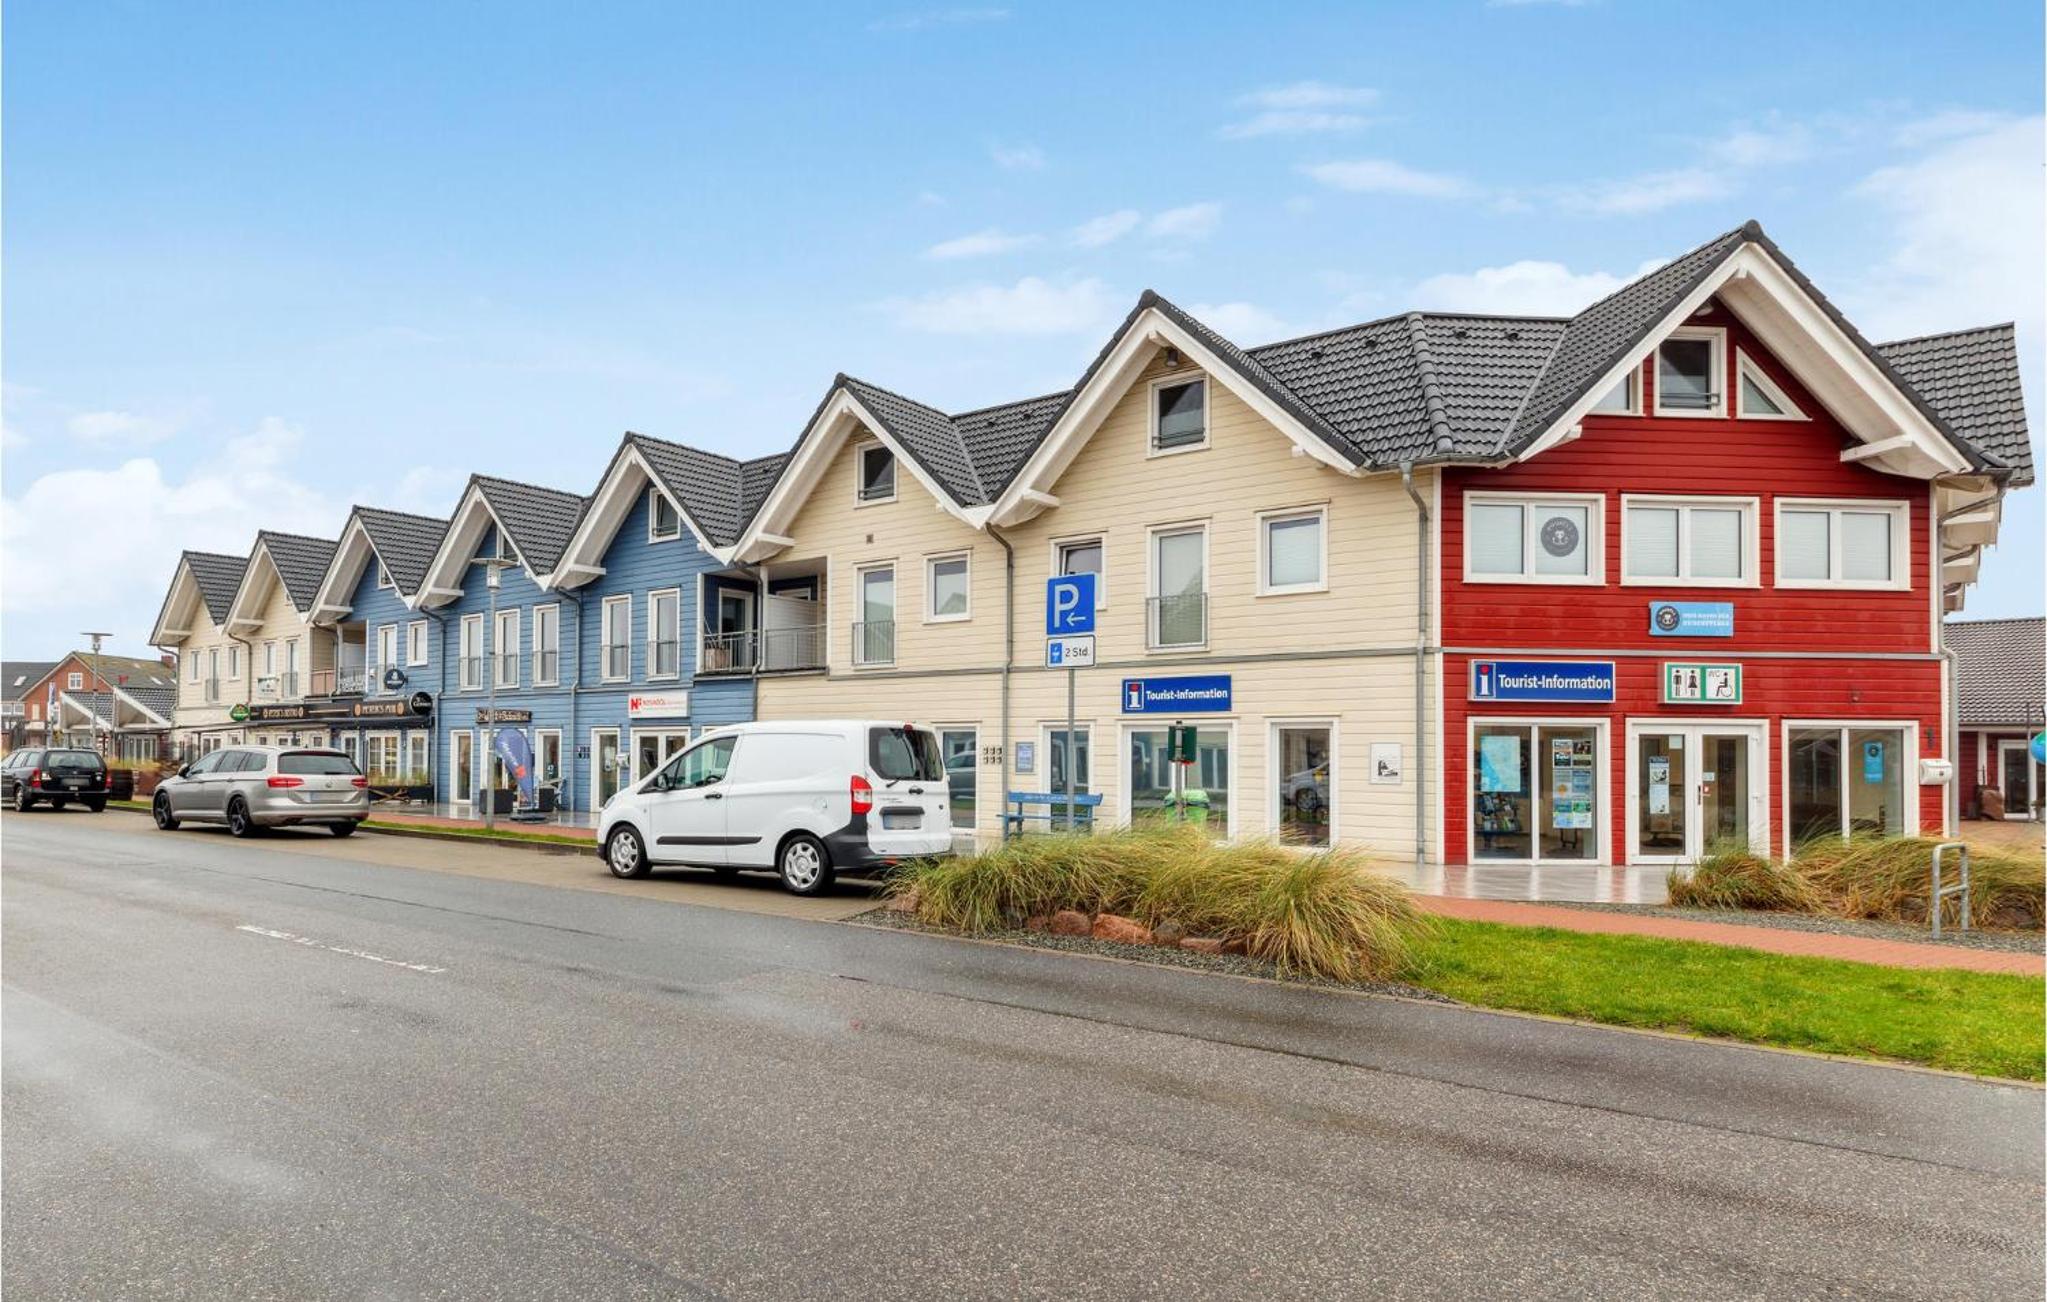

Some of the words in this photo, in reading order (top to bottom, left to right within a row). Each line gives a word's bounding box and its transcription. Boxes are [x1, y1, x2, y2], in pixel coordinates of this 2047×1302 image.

[1054, 584, 1079, 628] P
[1065, 647, 1071, 658] 2
[1708, 670, 1720, 678] WC
[1498, 674, 1611, 689] Tourist-Information
[1146, 688, 1228, 700] Tourist-Information
